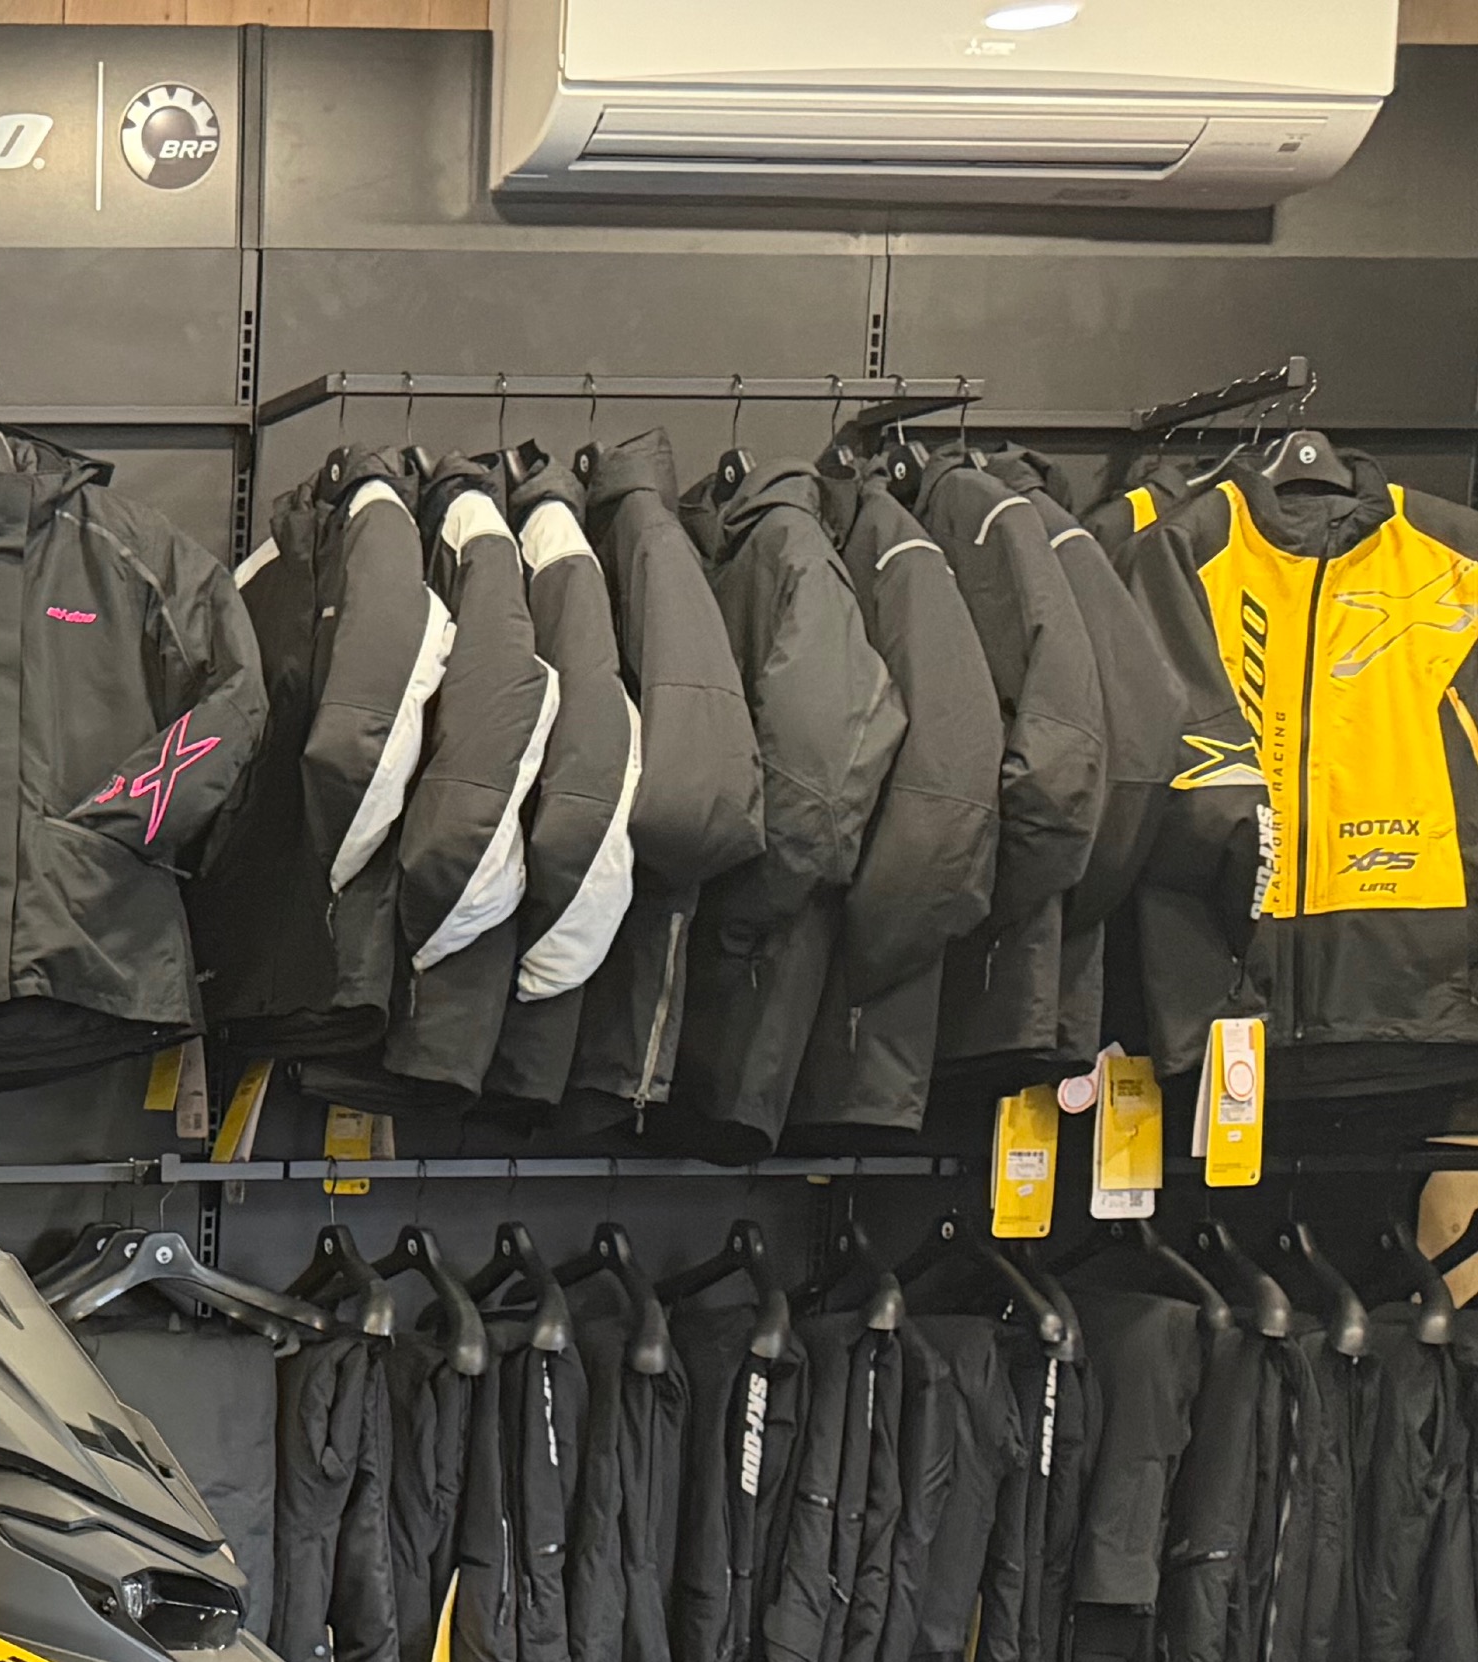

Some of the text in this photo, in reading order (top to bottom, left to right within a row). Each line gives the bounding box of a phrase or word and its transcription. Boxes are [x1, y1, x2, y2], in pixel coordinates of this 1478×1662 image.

[159, 139, 218, 159] BRP
[1273, 711, 1286, 791] RACING
[1338, 819, 1420, 839] ROTAX
[1337, 847, 1421, 875] XPS
[741, 1372, 768, 1496] ski-doo
